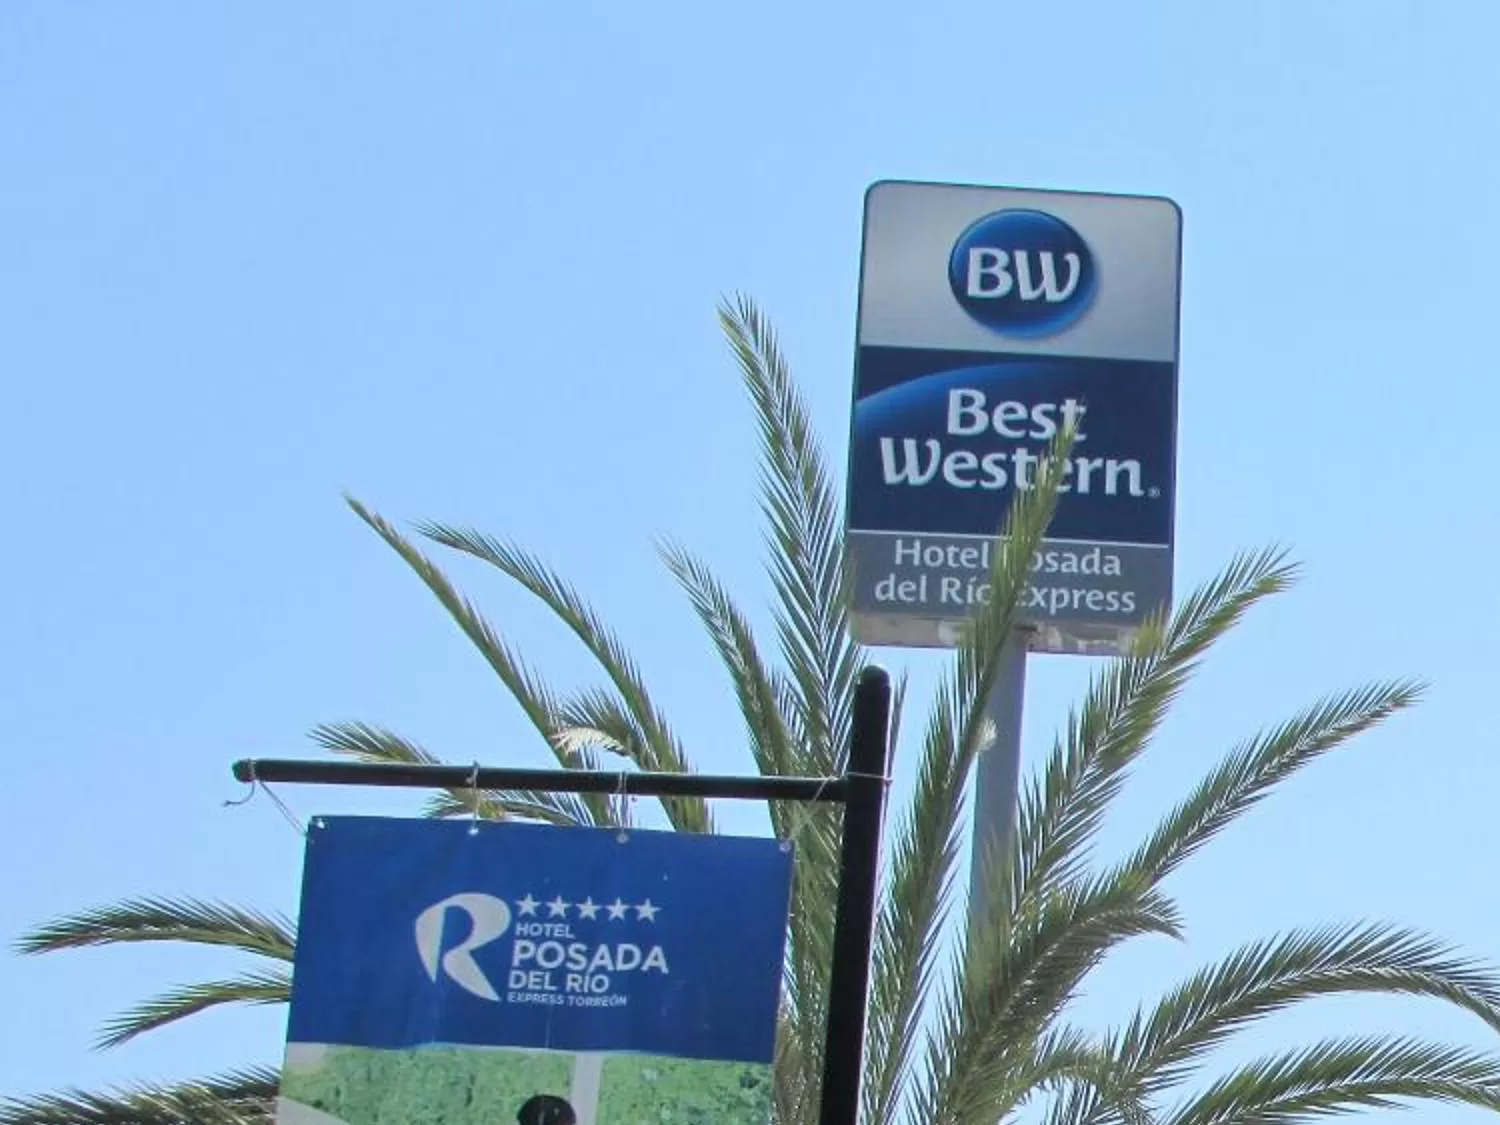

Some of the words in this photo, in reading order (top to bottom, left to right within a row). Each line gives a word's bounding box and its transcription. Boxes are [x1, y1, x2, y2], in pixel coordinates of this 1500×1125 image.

[966, 246, 1081, 302] BW
[946, 388, 1088, 442] Best
[894, 539, 989, 569] Hotel
[1012, 545, 1122, 576] osada
[875, 573, 927, 603] del
[515, 921, 576, 939] HOTEL
[511, 938, 670, 975] POSADA
[507, 969, 558, 991] DEL
[506, 991, 565, 1006] EXPRESS
